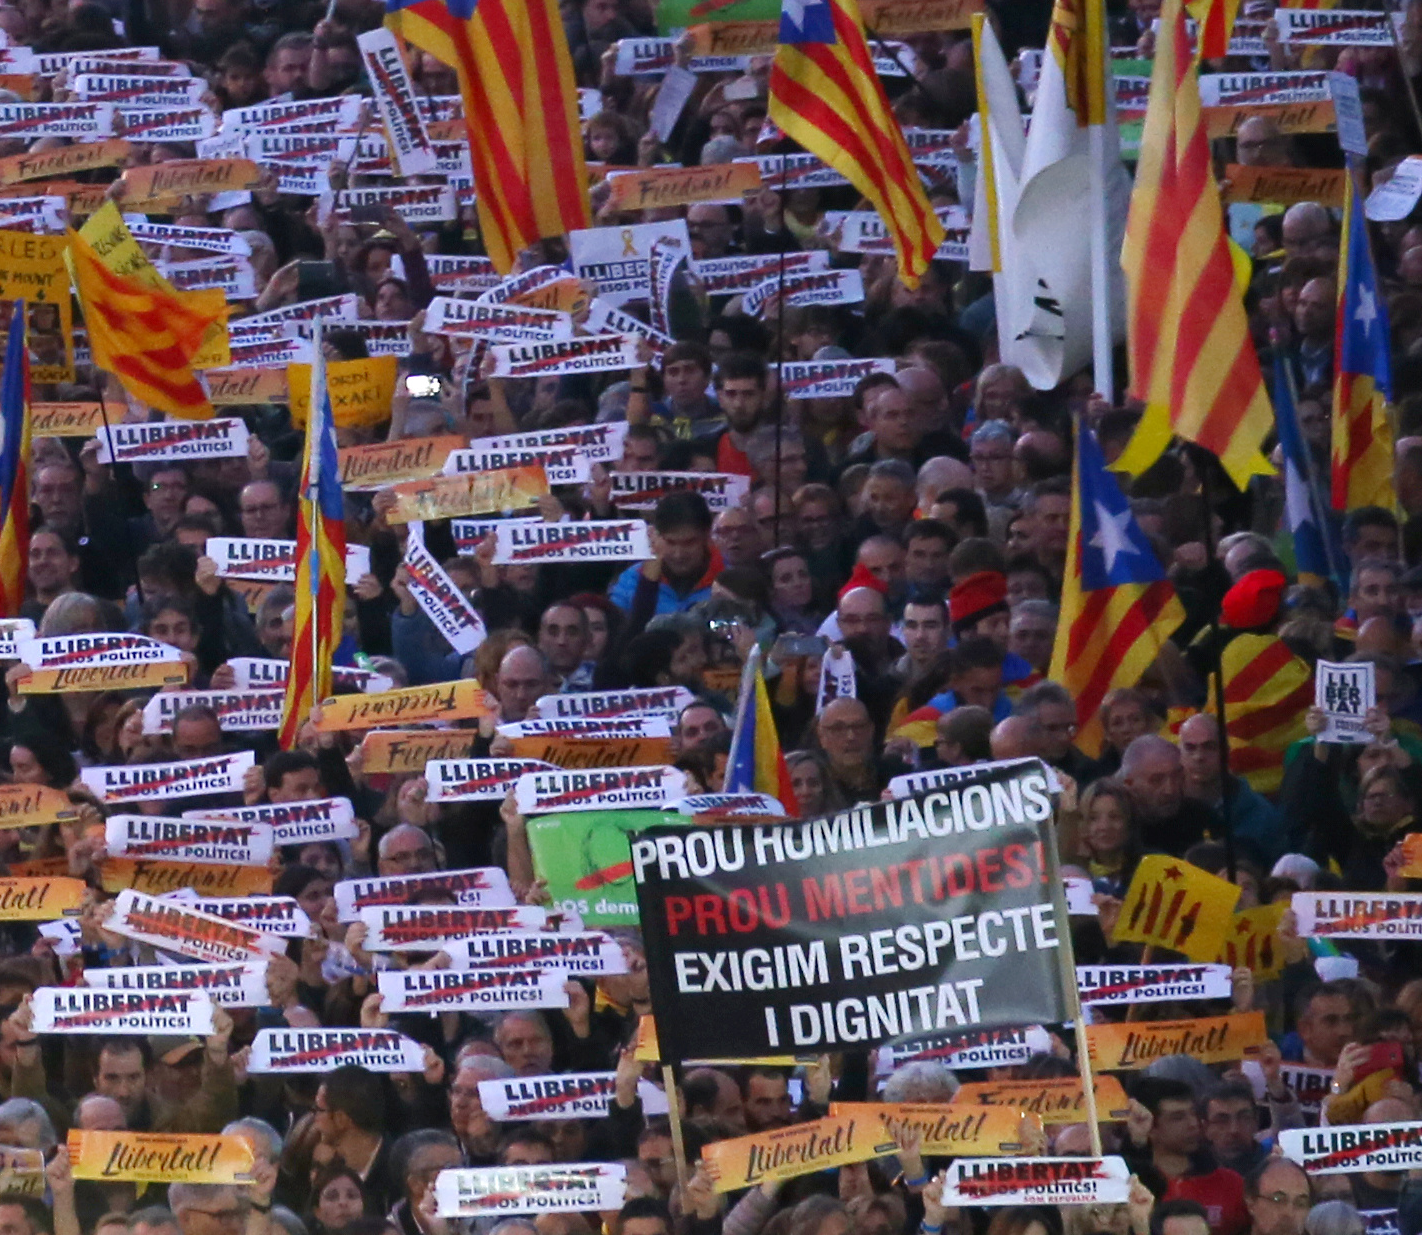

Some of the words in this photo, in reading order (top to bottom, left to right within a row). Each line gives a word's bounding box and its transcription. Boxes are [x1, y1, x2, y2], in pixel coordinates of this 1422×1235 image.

[116, 421, 232, 445] LLIBERTAT
[105, 758, 231, 786] LLIBERTAT
[126, 822, 251, 847] LLIBERTAT
[633, 832, 743, 881] PROU
[755, 778, 1050, 864] HUMILIACIONS
[664, 884, 789, 935] PROU
[800, 842, 1048, 923] MENTIDES!
[382, 907, 519, 932] LLIBERTAT
[673, 940, 827, 994] EXIGIM
[841, 904, 1060, 982] RESPECTE
[403, 969, 542, 993] LLIBERTAT
[54, 991, 190, 1015] LLIBERTAT
[765, 1013, 779, 1046] I
[789, 979, 984, 1045] DIGNITAT
[269, 1032, 403, 1053] LLIBERTAT
[103, 1137, 220, 1178] Llibertat!
[957, 1161, 1098, 1185] LLIBERTAT
